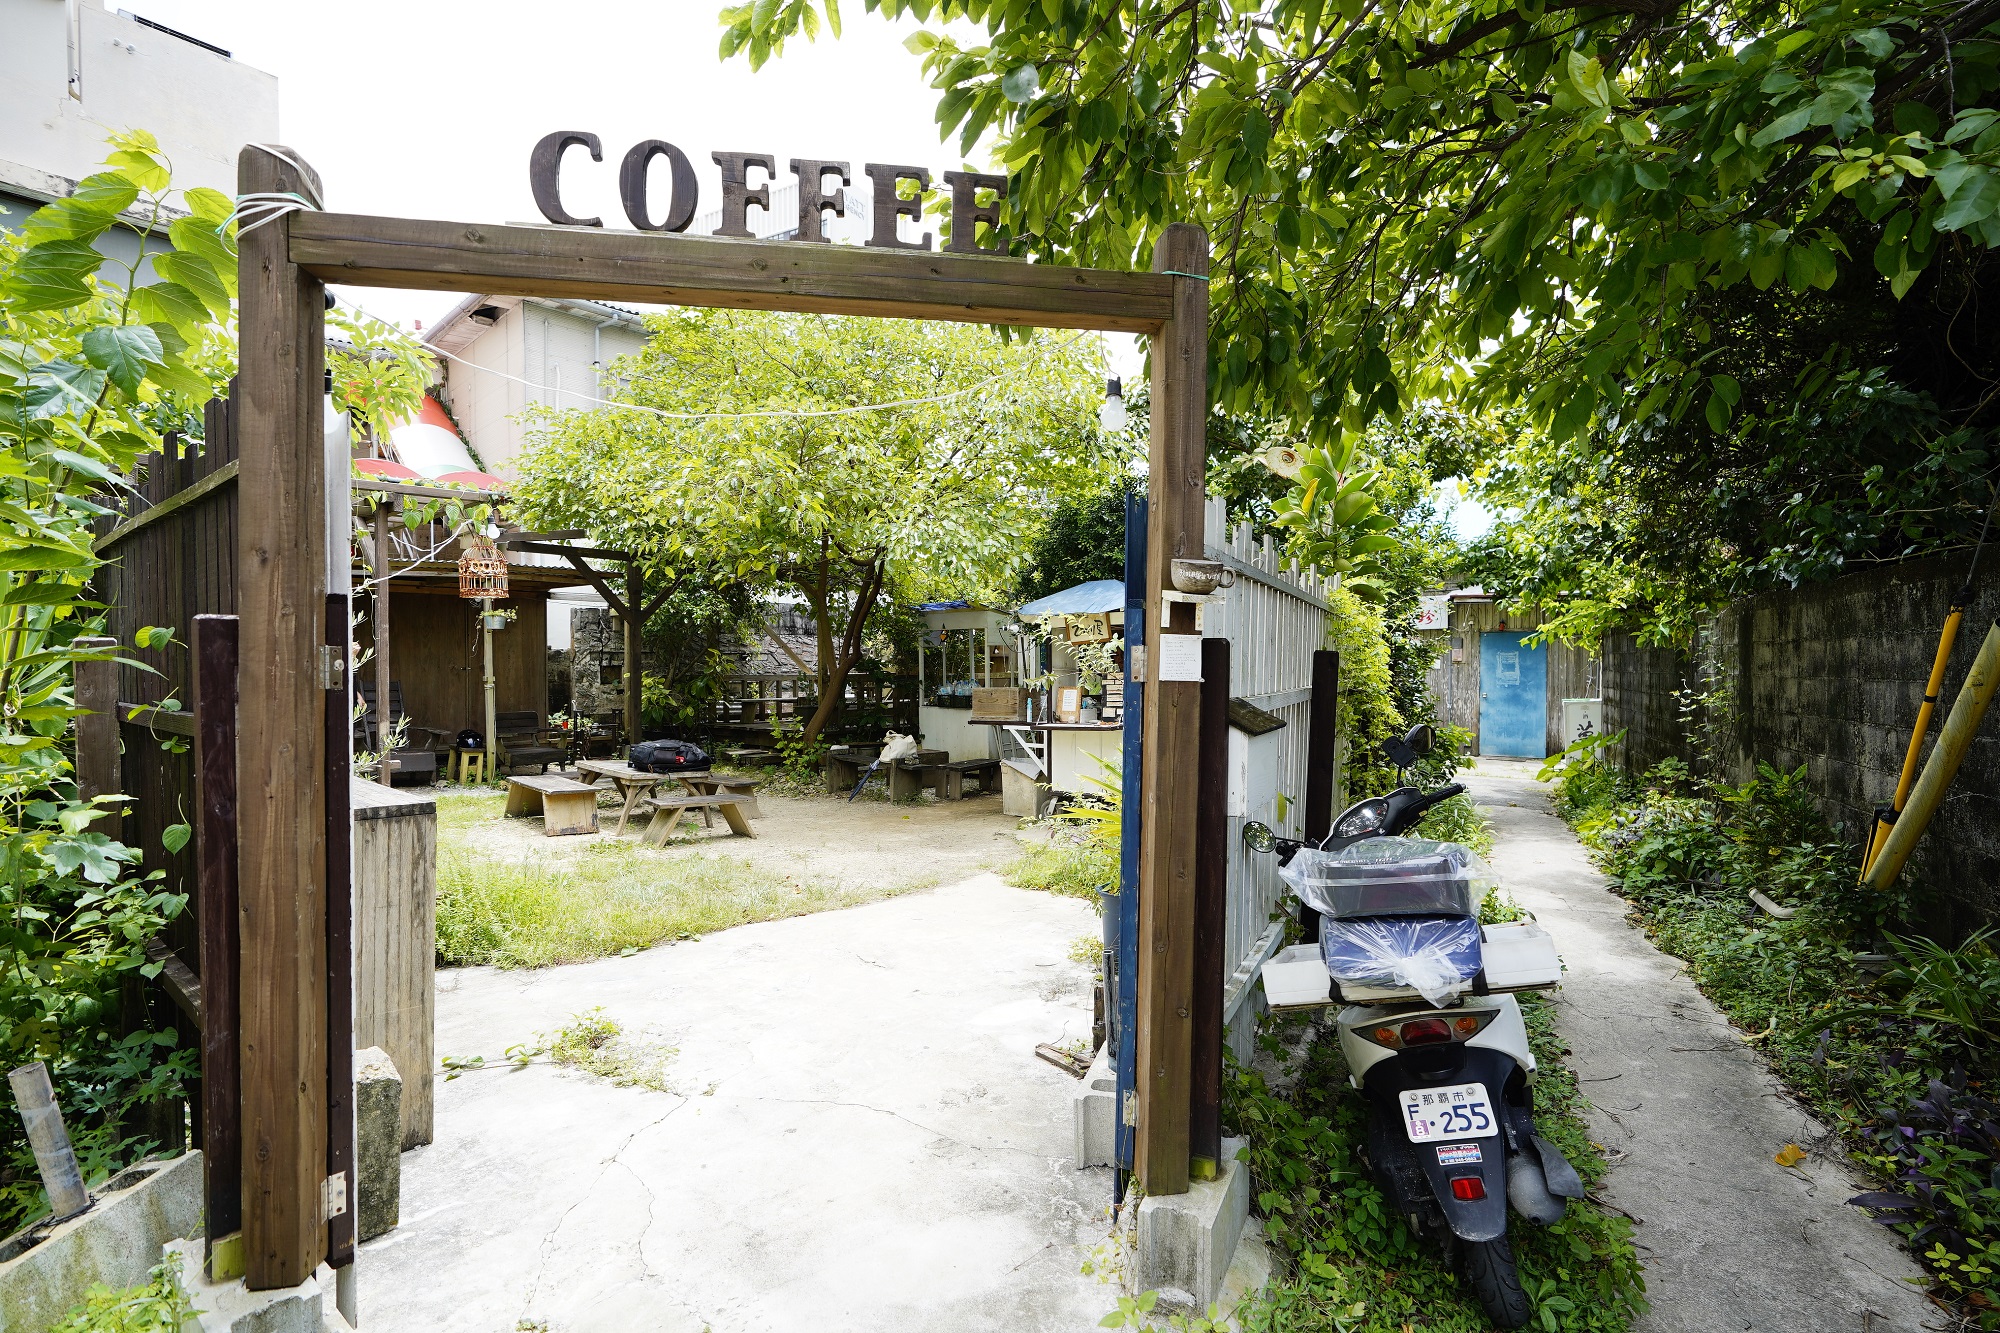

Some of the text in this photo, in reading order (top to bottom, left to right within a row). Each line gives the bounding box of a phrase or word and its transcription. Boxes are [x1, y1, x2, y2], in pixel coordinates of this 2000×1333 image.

[530, 130, 1010, 257] COFFEE
[1421, 1091, 1465, 1106] 那覇市
[1407, 1103, 1420, 1121] F
